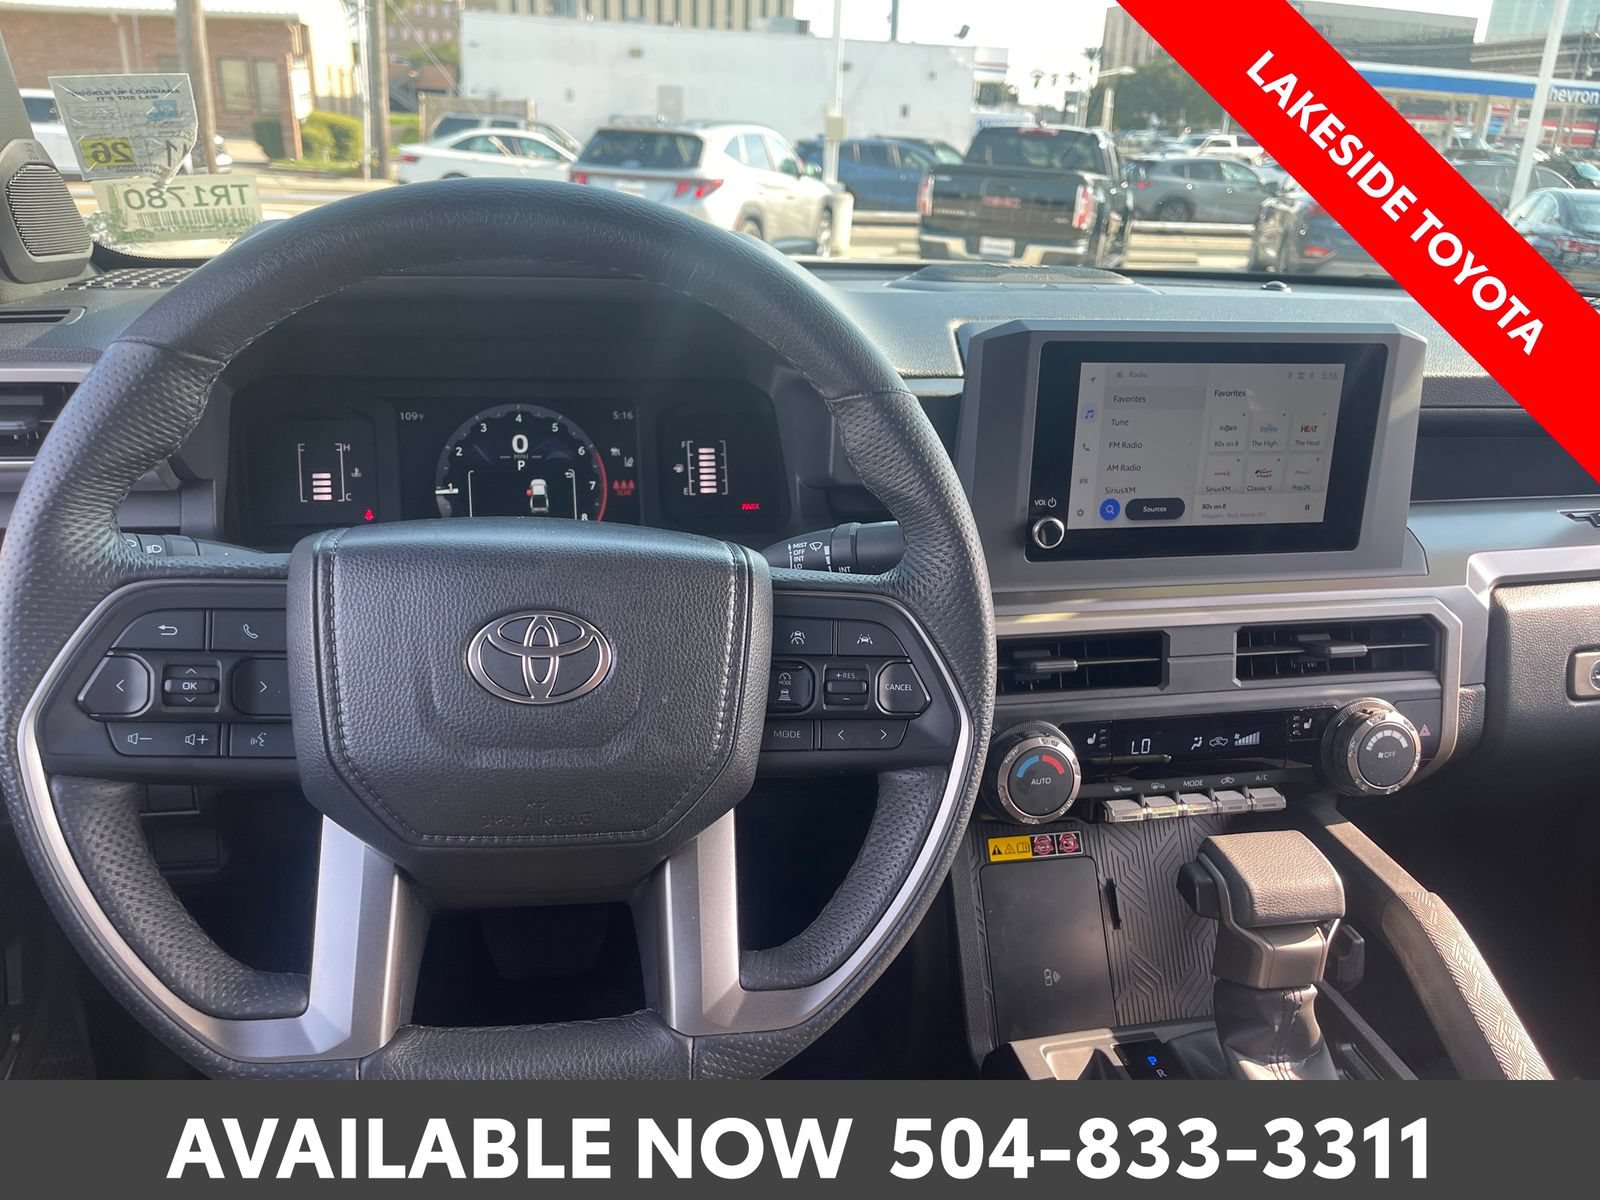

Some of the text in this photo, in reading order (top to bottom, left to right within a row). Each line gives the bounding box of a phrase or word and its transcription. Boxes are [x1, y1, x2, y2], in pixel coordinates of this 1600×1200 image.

[1551, 87, 1600, 105] hevron
[1214, 389, 1246, 397] Favorites
[1113, 395, 1147, 403] Favorites
[515, 413, 523, 423] 4
[612, 410, 634, 420] 5:16
[1111, 418, 1129, 426] Tune
[480, 422, 488, 433] 3
[551, 422, 559, 432] 5
[511, 433, 529, 454] 0
[1109, 441, 1143, 449] FM Radio
[455, 446, 463, 456] 2
[578, 446, 586, 456] 6
[517, 460, 526, 471] P
[1106, 464, 1142, 472] AM Radio
[589, 480, 596, 490] 7
[1105, 486, 1136, 495] SiriusXM
[1143, 505, 1167, 513] Sources
[182, 682, 198, 690] OK
[885, 683, 913, 691] CANCEL
[773, 730, 801, 739] MODE
[1131, 738, 1151, 755] LO
[1030, 777, 1052, 786] AUTO
[1255, 773, 1268, 781] A/C
[1183, 779, 1204, 788] MODE
[524, 811, 593, 826] AIRBAG
[1156, 1069, 1168, 1078] R
